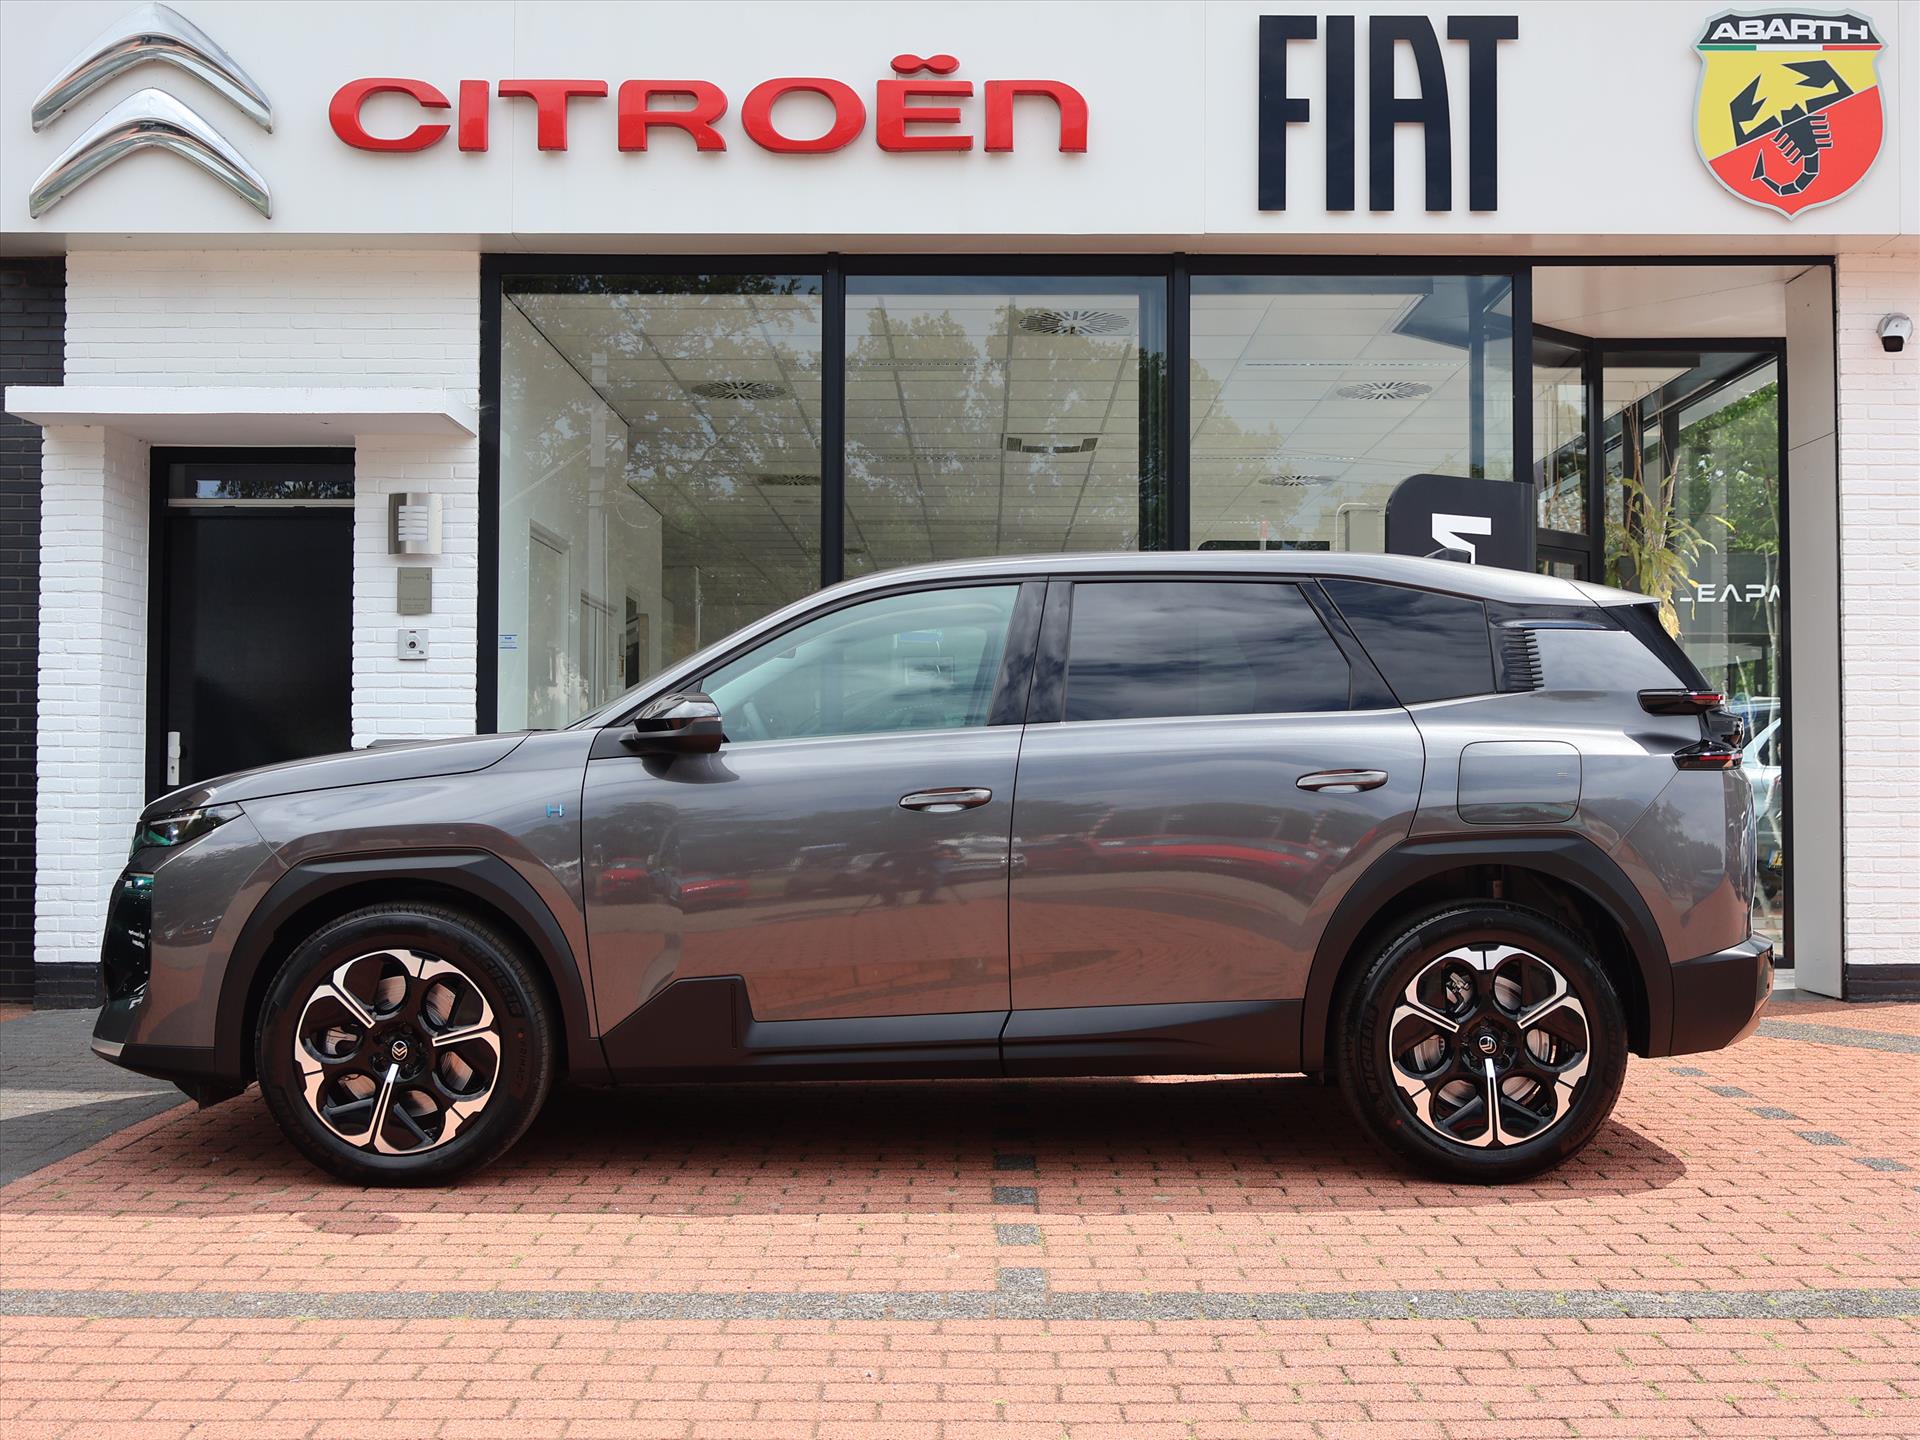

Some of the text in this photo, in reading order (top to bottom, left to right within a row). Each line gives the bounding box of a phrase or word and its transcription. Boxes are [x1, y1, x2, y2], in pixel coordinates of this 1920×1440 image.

[1709, 17, 1870, 41] ABARTH
[329, 54, 1089, 154] CITROËN
[1258, 15, 1519, 211] FIAT
